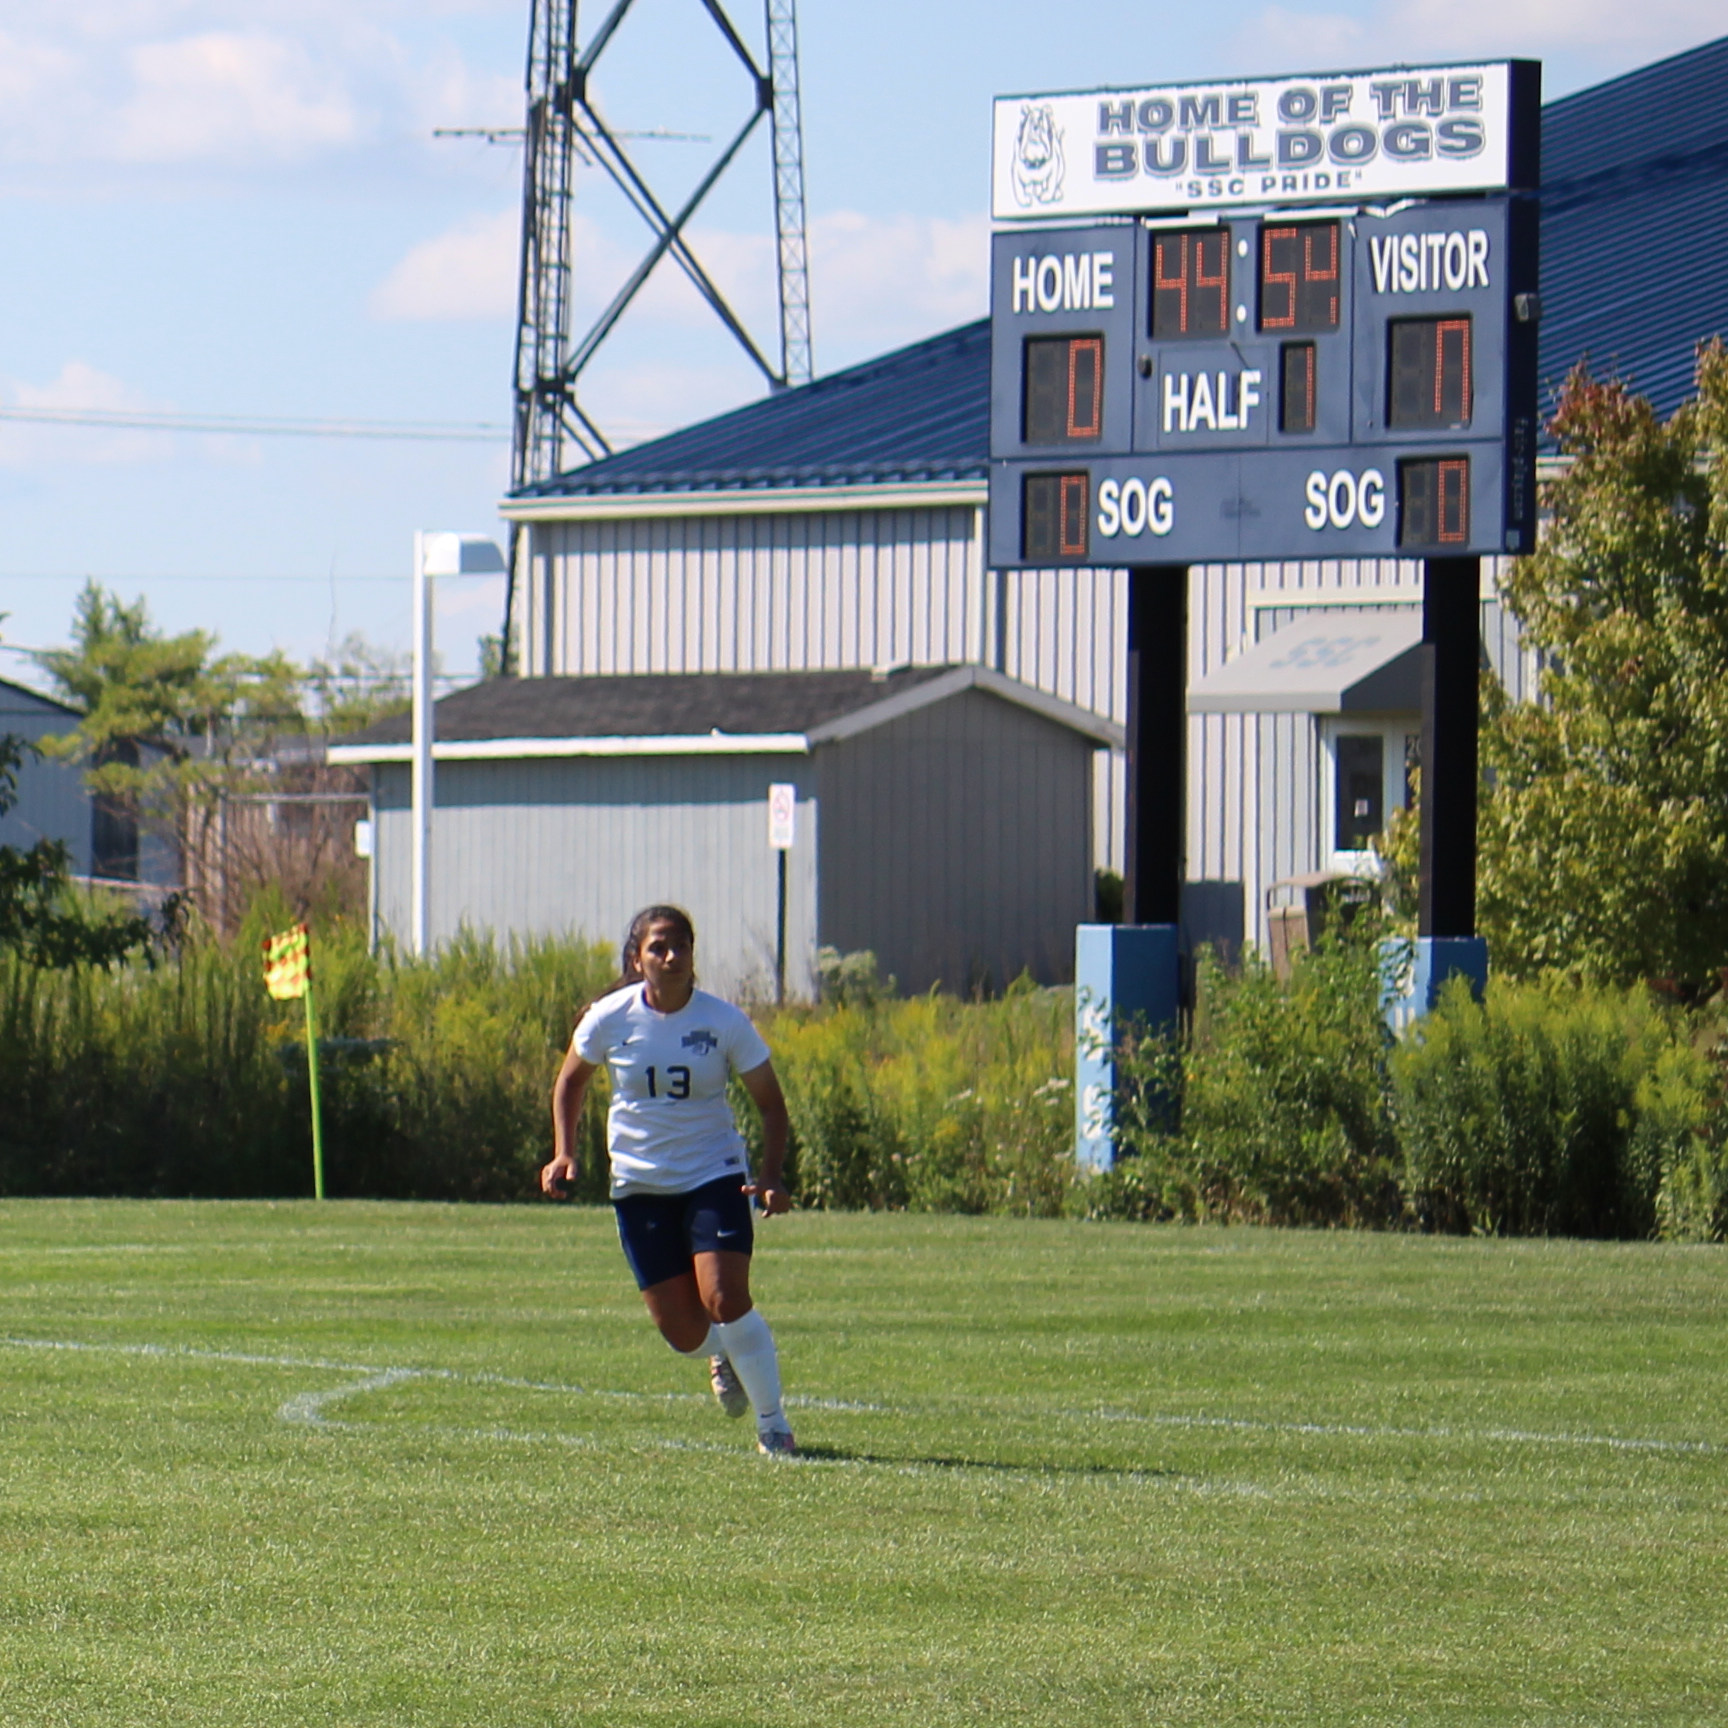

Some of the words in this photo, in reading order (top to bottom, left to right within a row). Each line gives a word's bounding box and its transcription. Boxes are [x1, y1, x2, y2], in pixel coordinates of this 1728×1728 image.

[1097, 91, 1260, 136] HOME
[1277, 83, 1353, 125] OF
[1369, 73, 1484, 121] THE
[1093, 115, 1486, 182] BULLDOGS
[1012, 252, 1114, 313] HOME
[1371, 229, 1489, 293] VISITOR
[1067, 339, 1101, 438] 0
[1163, 370, 1261, 432] HALF
[1060, 475, 1087, 555] 0
[1097, 477, 1174, 537] SOG
[1305, 468, 1385, 531] SOG
[1438, 460, 1467, 543] 0
[645, 1065, 691, 1100] 13
